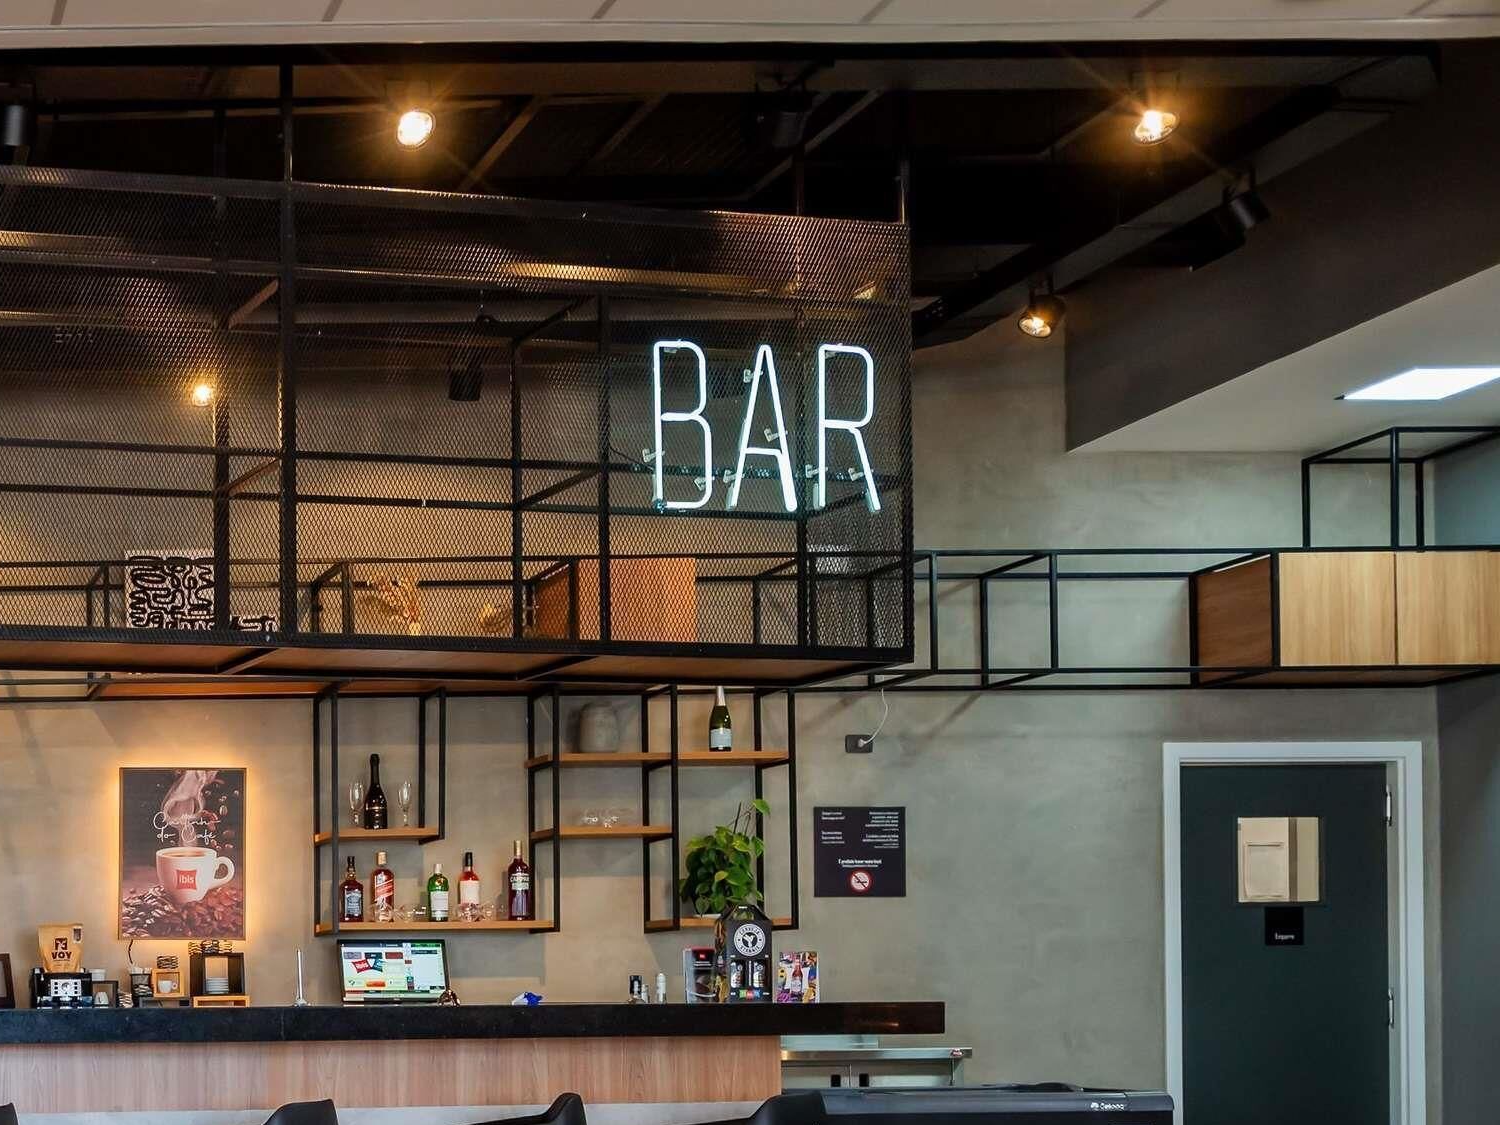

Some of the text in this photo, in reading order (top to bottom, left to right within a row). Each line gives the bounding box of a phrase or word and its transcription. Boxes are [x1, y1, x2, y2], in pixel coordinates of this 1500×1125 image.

[653, 339, 881, 511] BAR
[157, 828, 177, 843] do
[179, 874, 195, 884] ibis
[51, 951, 72, 959] VOY
